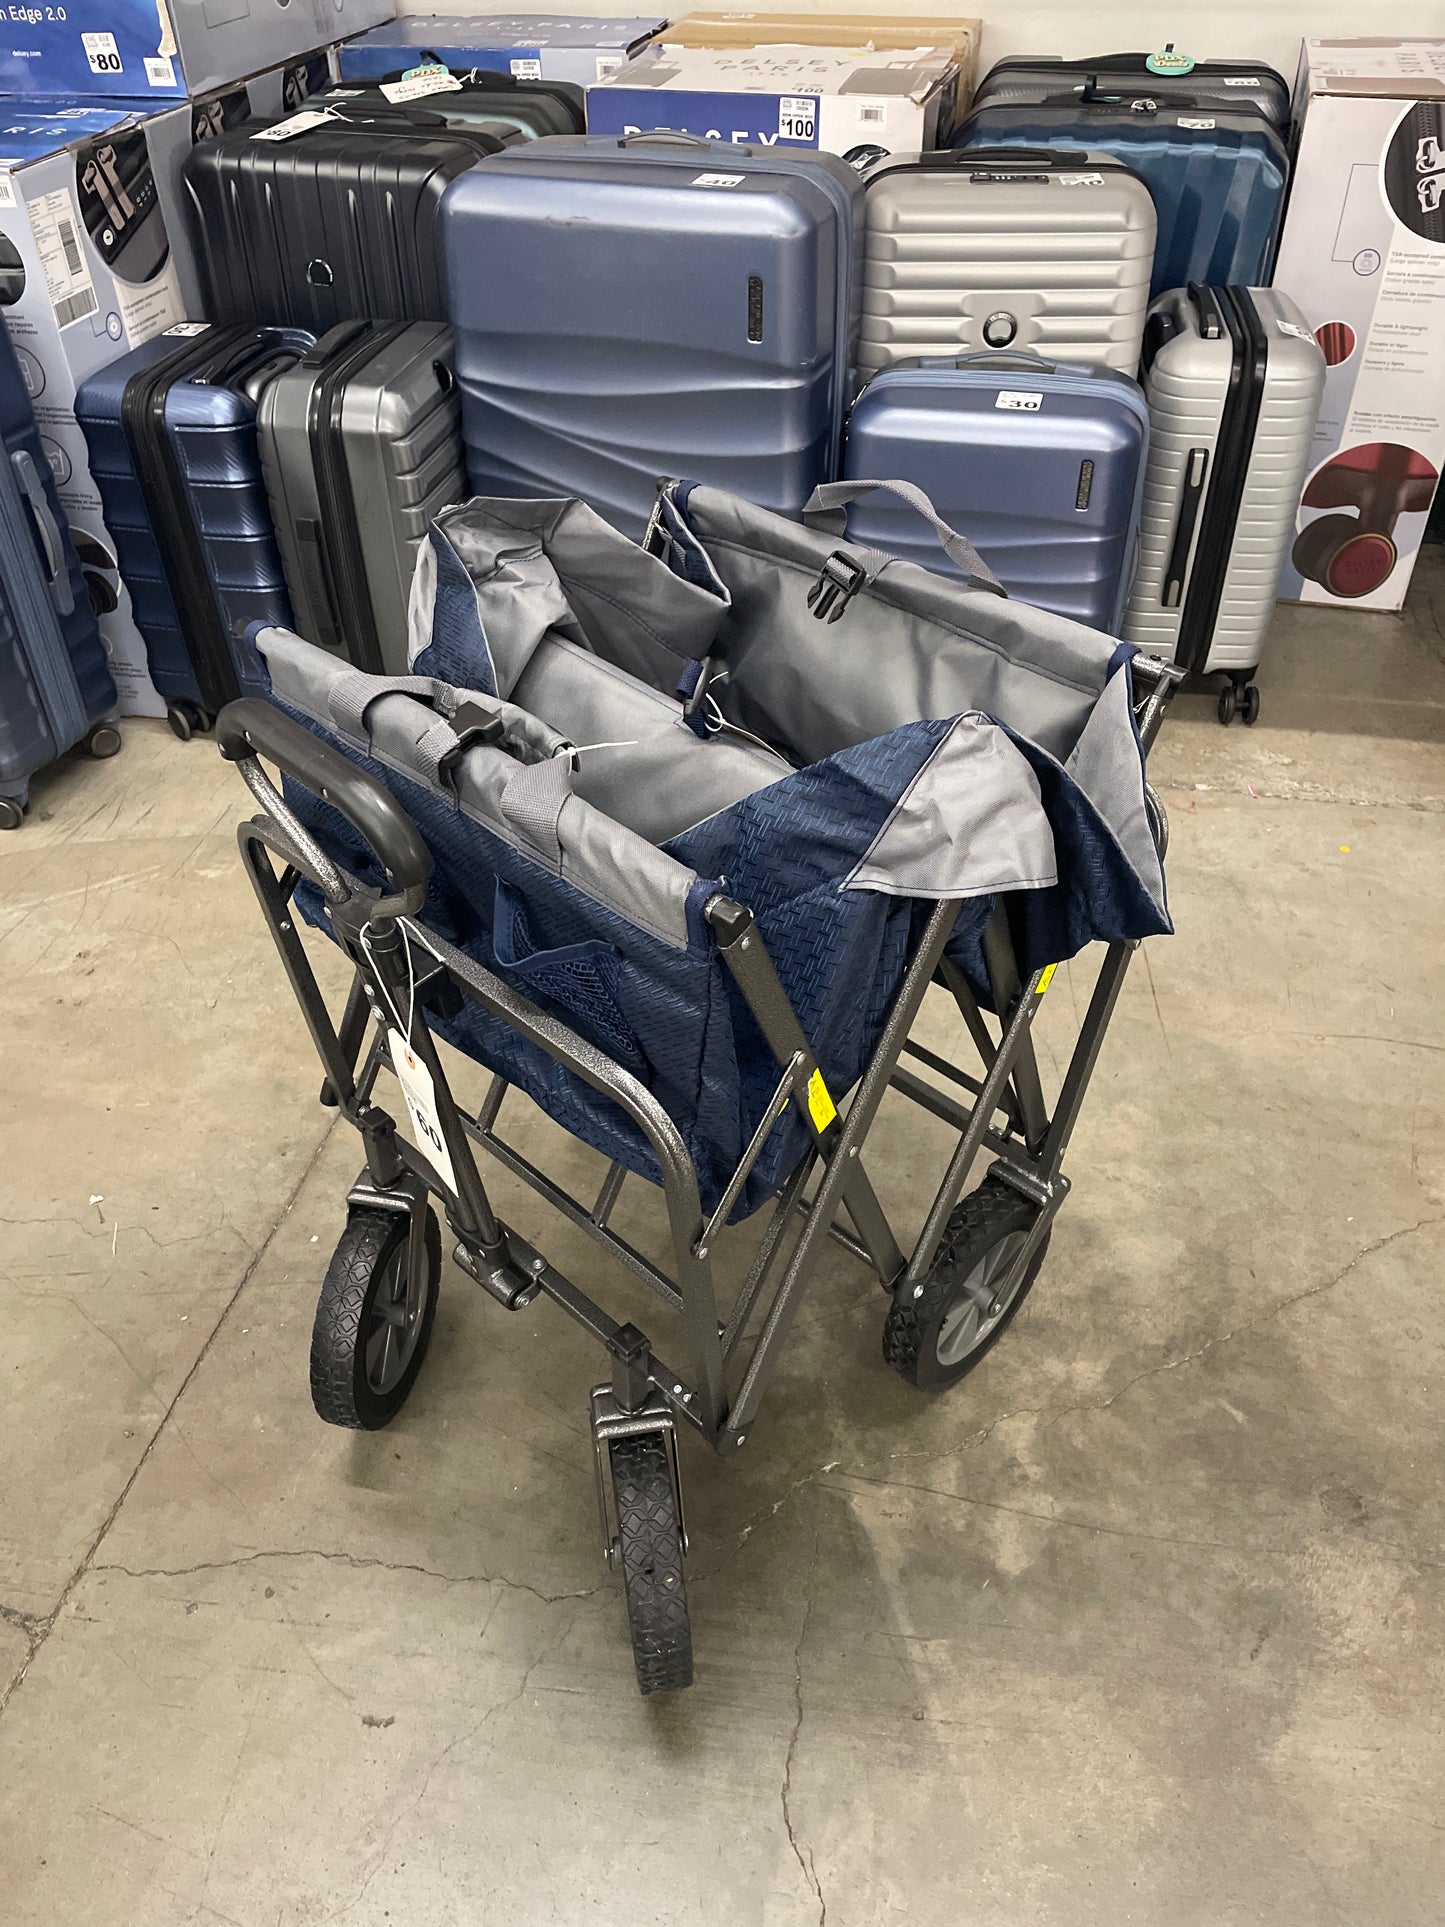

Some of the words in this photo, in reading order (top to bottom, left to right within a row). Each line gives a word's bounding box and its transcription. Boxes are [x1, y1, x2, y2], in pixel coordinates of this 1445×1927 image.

[8, 6, 43, 24] Edge
[45, 7, 67, 21] 2.0
[90, 54, 120, 71] $80
[714, 58, 851, 67] DELSEY
[720, 65, 828, 73] PARIS
[781, 119, 814, 138] $100
[1001, 400, 1038, 409] $30
[407, 1098, 443, 1153] $60
